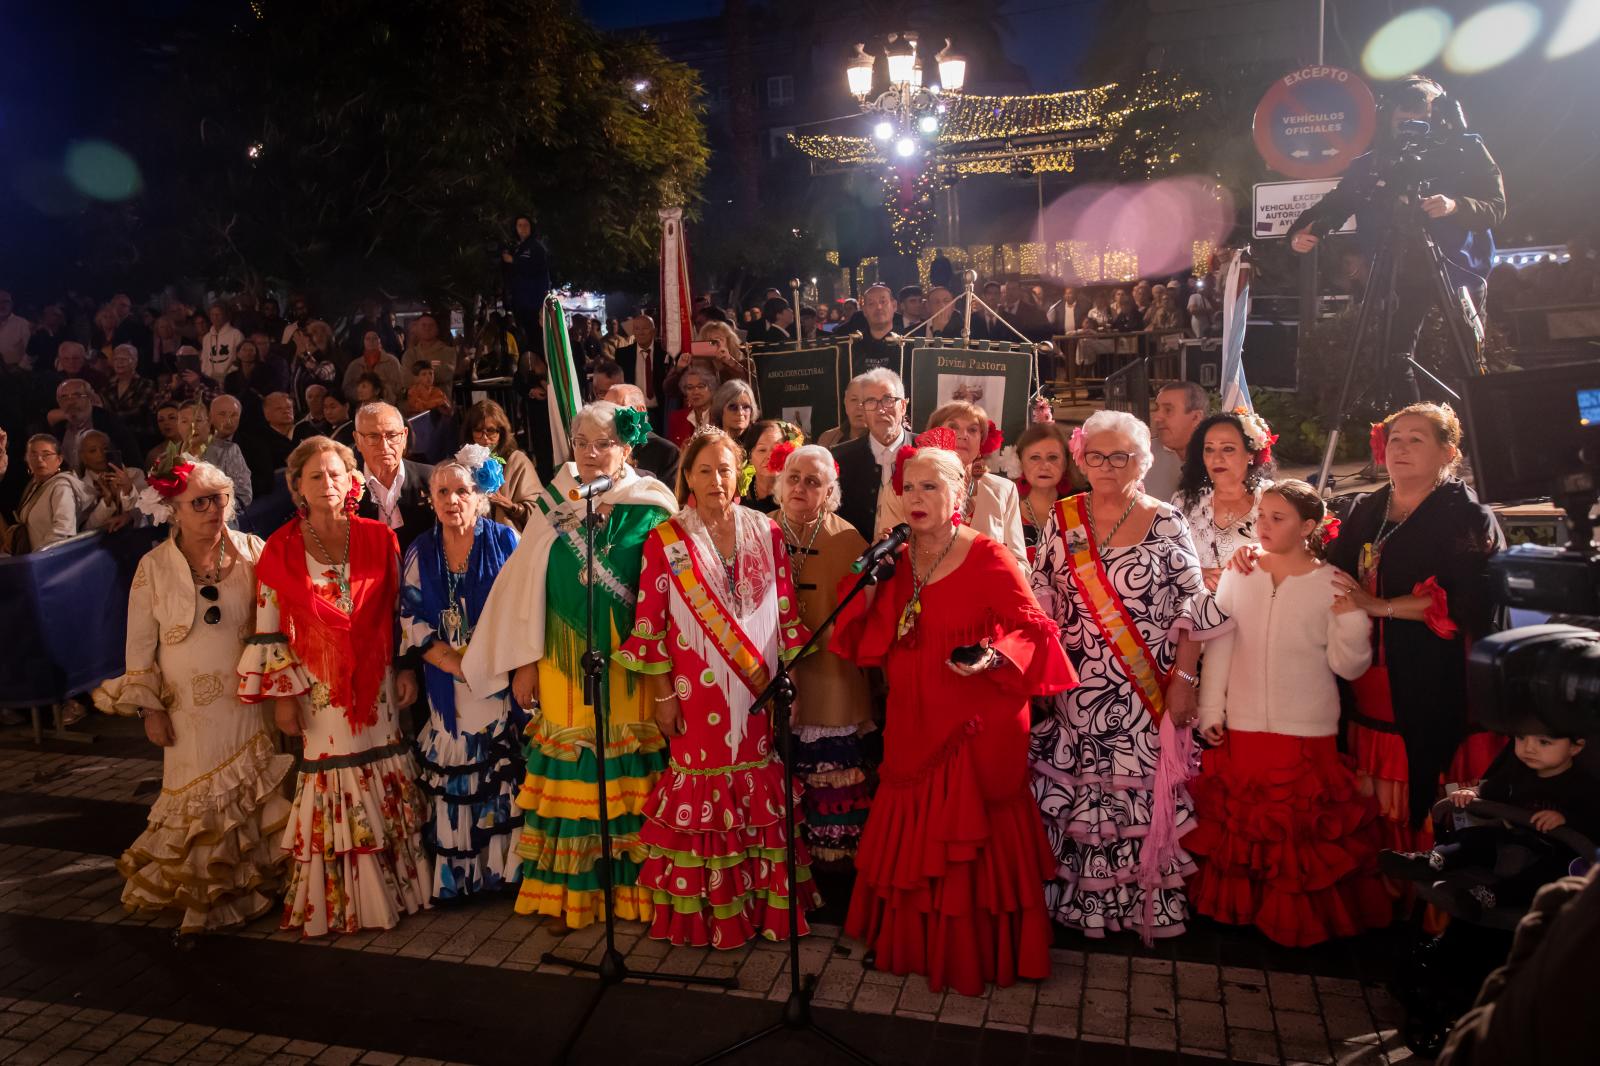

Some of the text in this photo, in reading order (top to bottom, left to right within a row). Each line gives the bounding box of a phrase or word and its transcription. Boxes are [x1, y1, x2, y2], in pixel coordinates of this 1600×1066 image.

[1284, 67, 1349, 87] EXCEPTO
[1285, 123, 1342, 136] OFICIALES
[937, 356, 1007, 372] Divina Pastora
